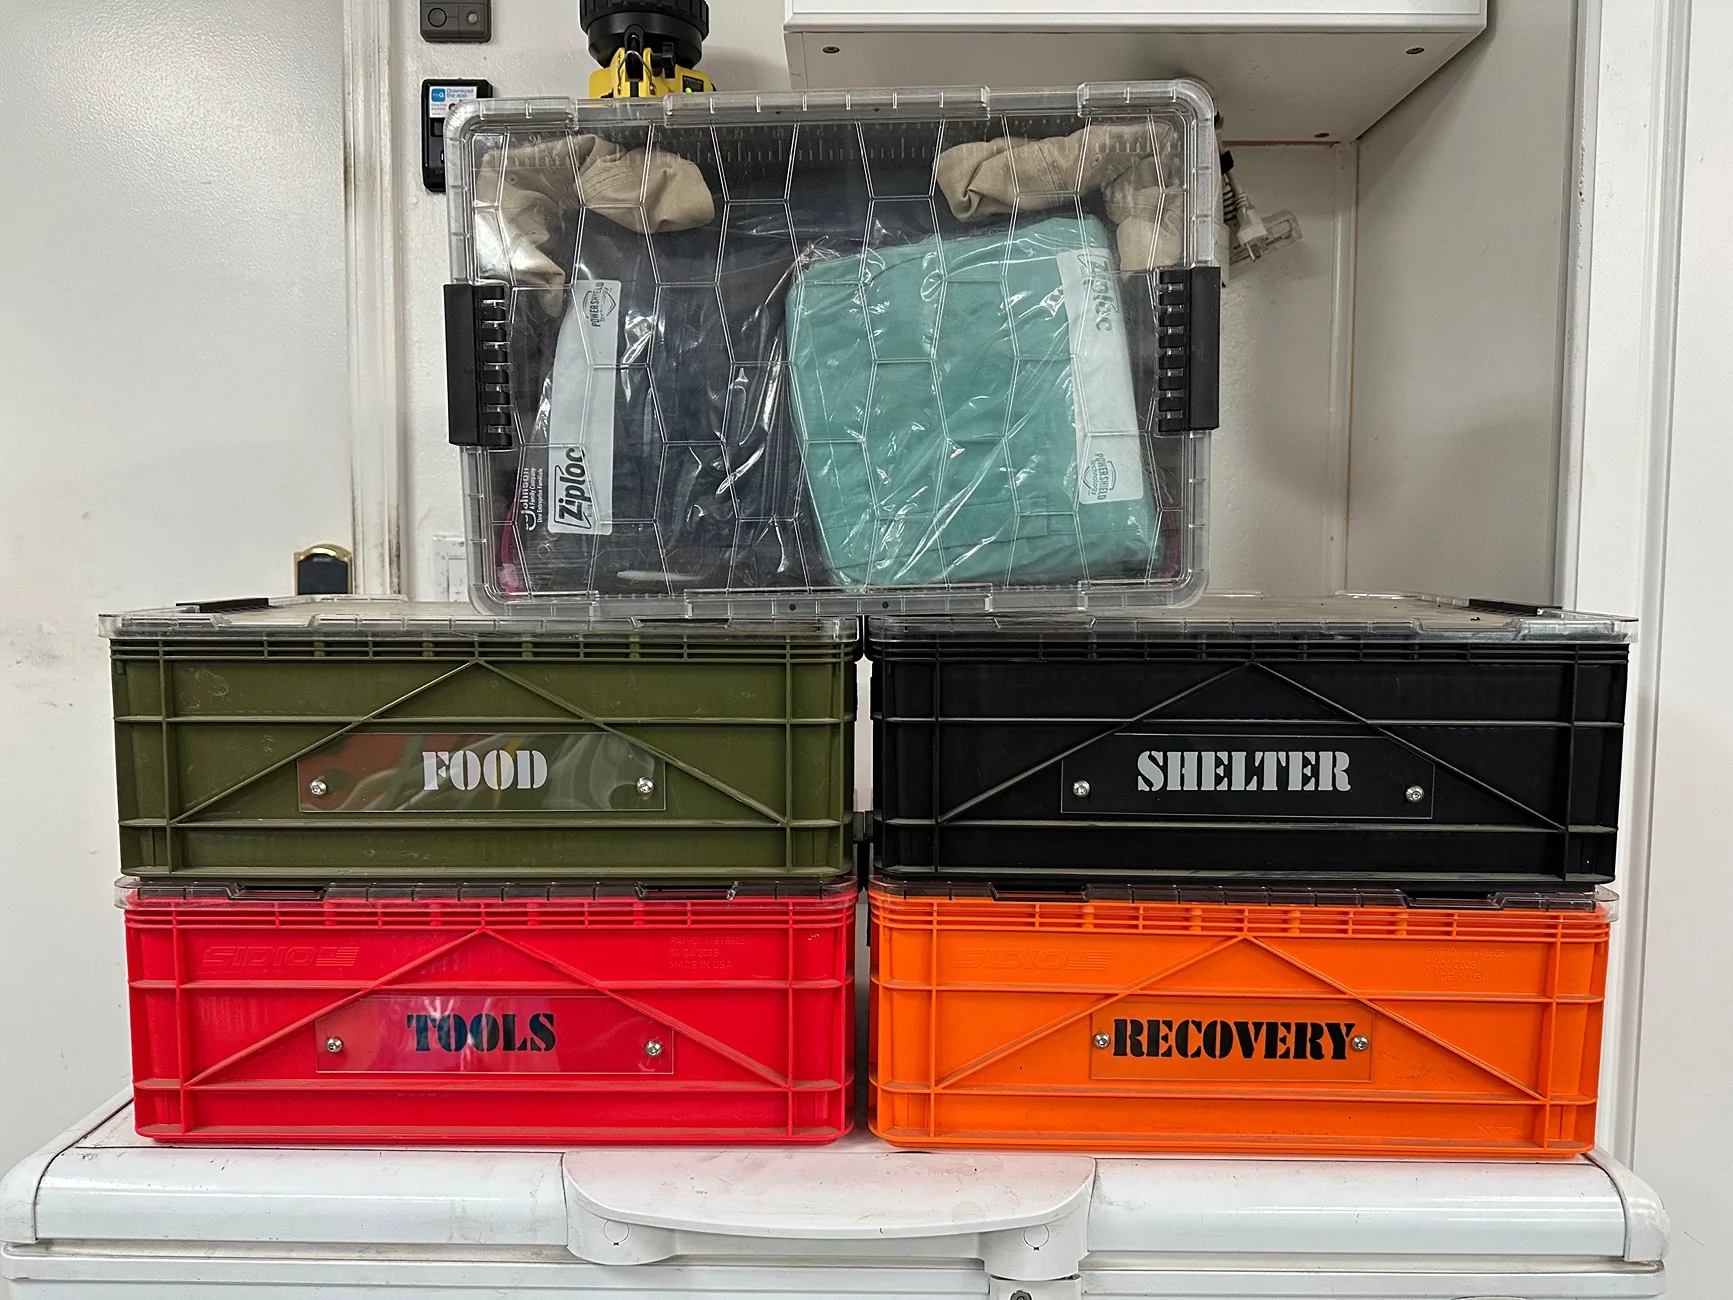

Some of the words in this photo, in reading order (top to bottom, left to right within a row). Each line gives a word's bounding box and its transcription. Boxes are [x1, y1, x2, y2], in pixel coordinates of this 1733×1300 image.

[558, 447, 592, 521] Ziploc
[423, 751, 548, 791] FOOD
[1137, 751, 1351, 793] SHELTER
[202, 946, 316, 966] SIDIO
[669, 935, 686, 945] PAT
[669, 960, 698, 970] MADE
[700, 960, 711, 969] IN
[713, 960, 733, 970] USA
[1469, 973, 1489, 983] USA
[406, 1012, 556, 1053] TOOLS
[1113, 1018, 1355, 1060] RECOVERY
